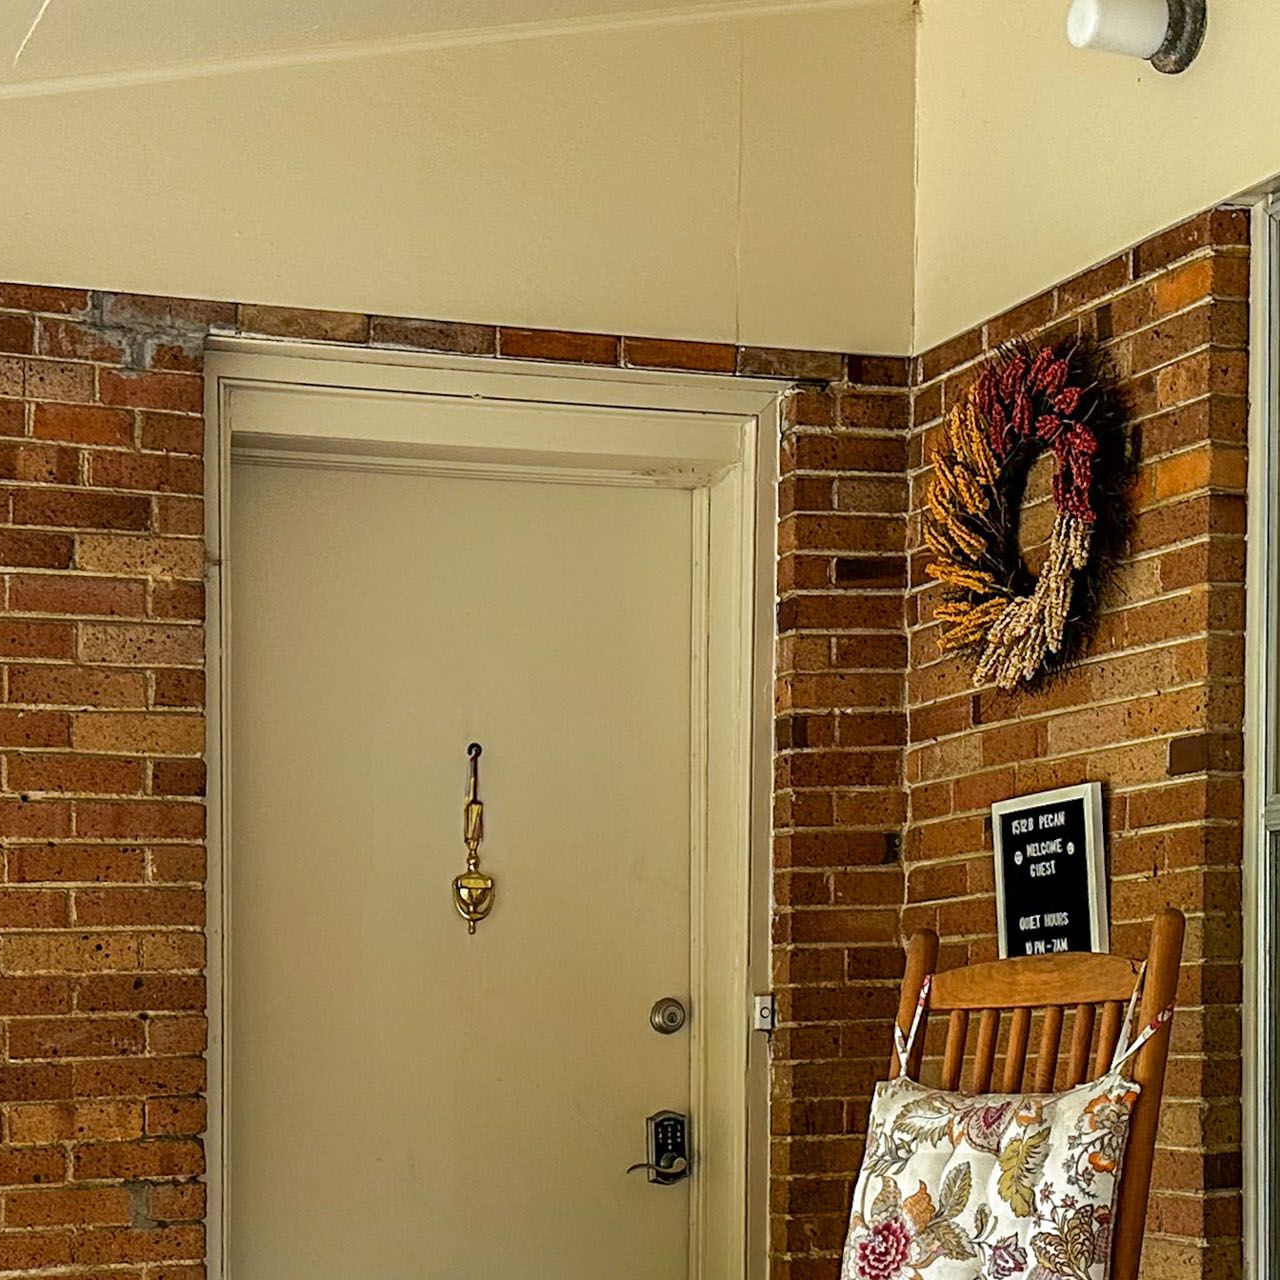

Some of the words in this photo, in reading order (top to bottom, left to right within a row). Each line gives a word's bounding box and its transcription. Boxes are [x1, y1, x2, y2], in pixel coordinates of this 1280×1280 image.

[1038, 811, 1066, 830] PECAN
[1026, 838, 1064, 858] WELCOME
[1030, 860, 1057, 878] GUEST
[1019, 914, 1041, 931] QUIET
[1044, 912, 1069, 928] HOURS
